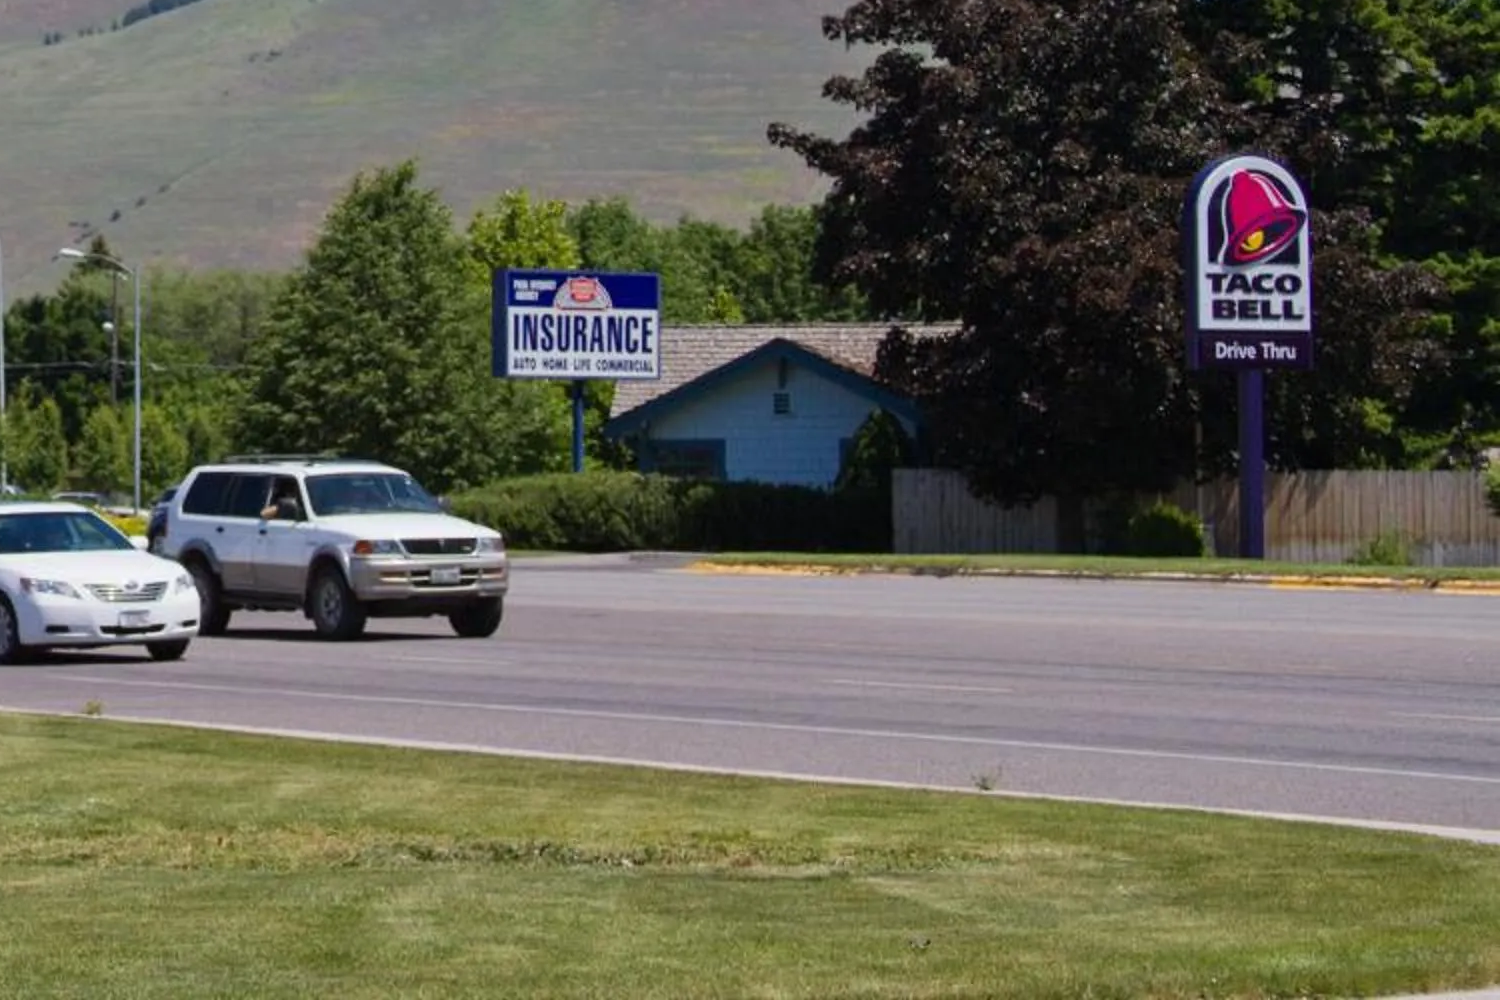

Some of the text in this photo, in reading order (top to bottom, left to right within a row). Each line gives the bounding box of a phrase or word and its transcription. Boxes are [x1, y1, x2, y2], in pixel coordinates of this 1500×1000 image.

[1206, 273, 1302, 295] TACO
[1212, 299, 1303, 320] BELL
[513, 313, 653, 354] INSURANCE
[1215, 341, 1296, 360] Drive Thru
[513, 358, 653, 373] AUTO HOME LIFE COMMERCIAL
